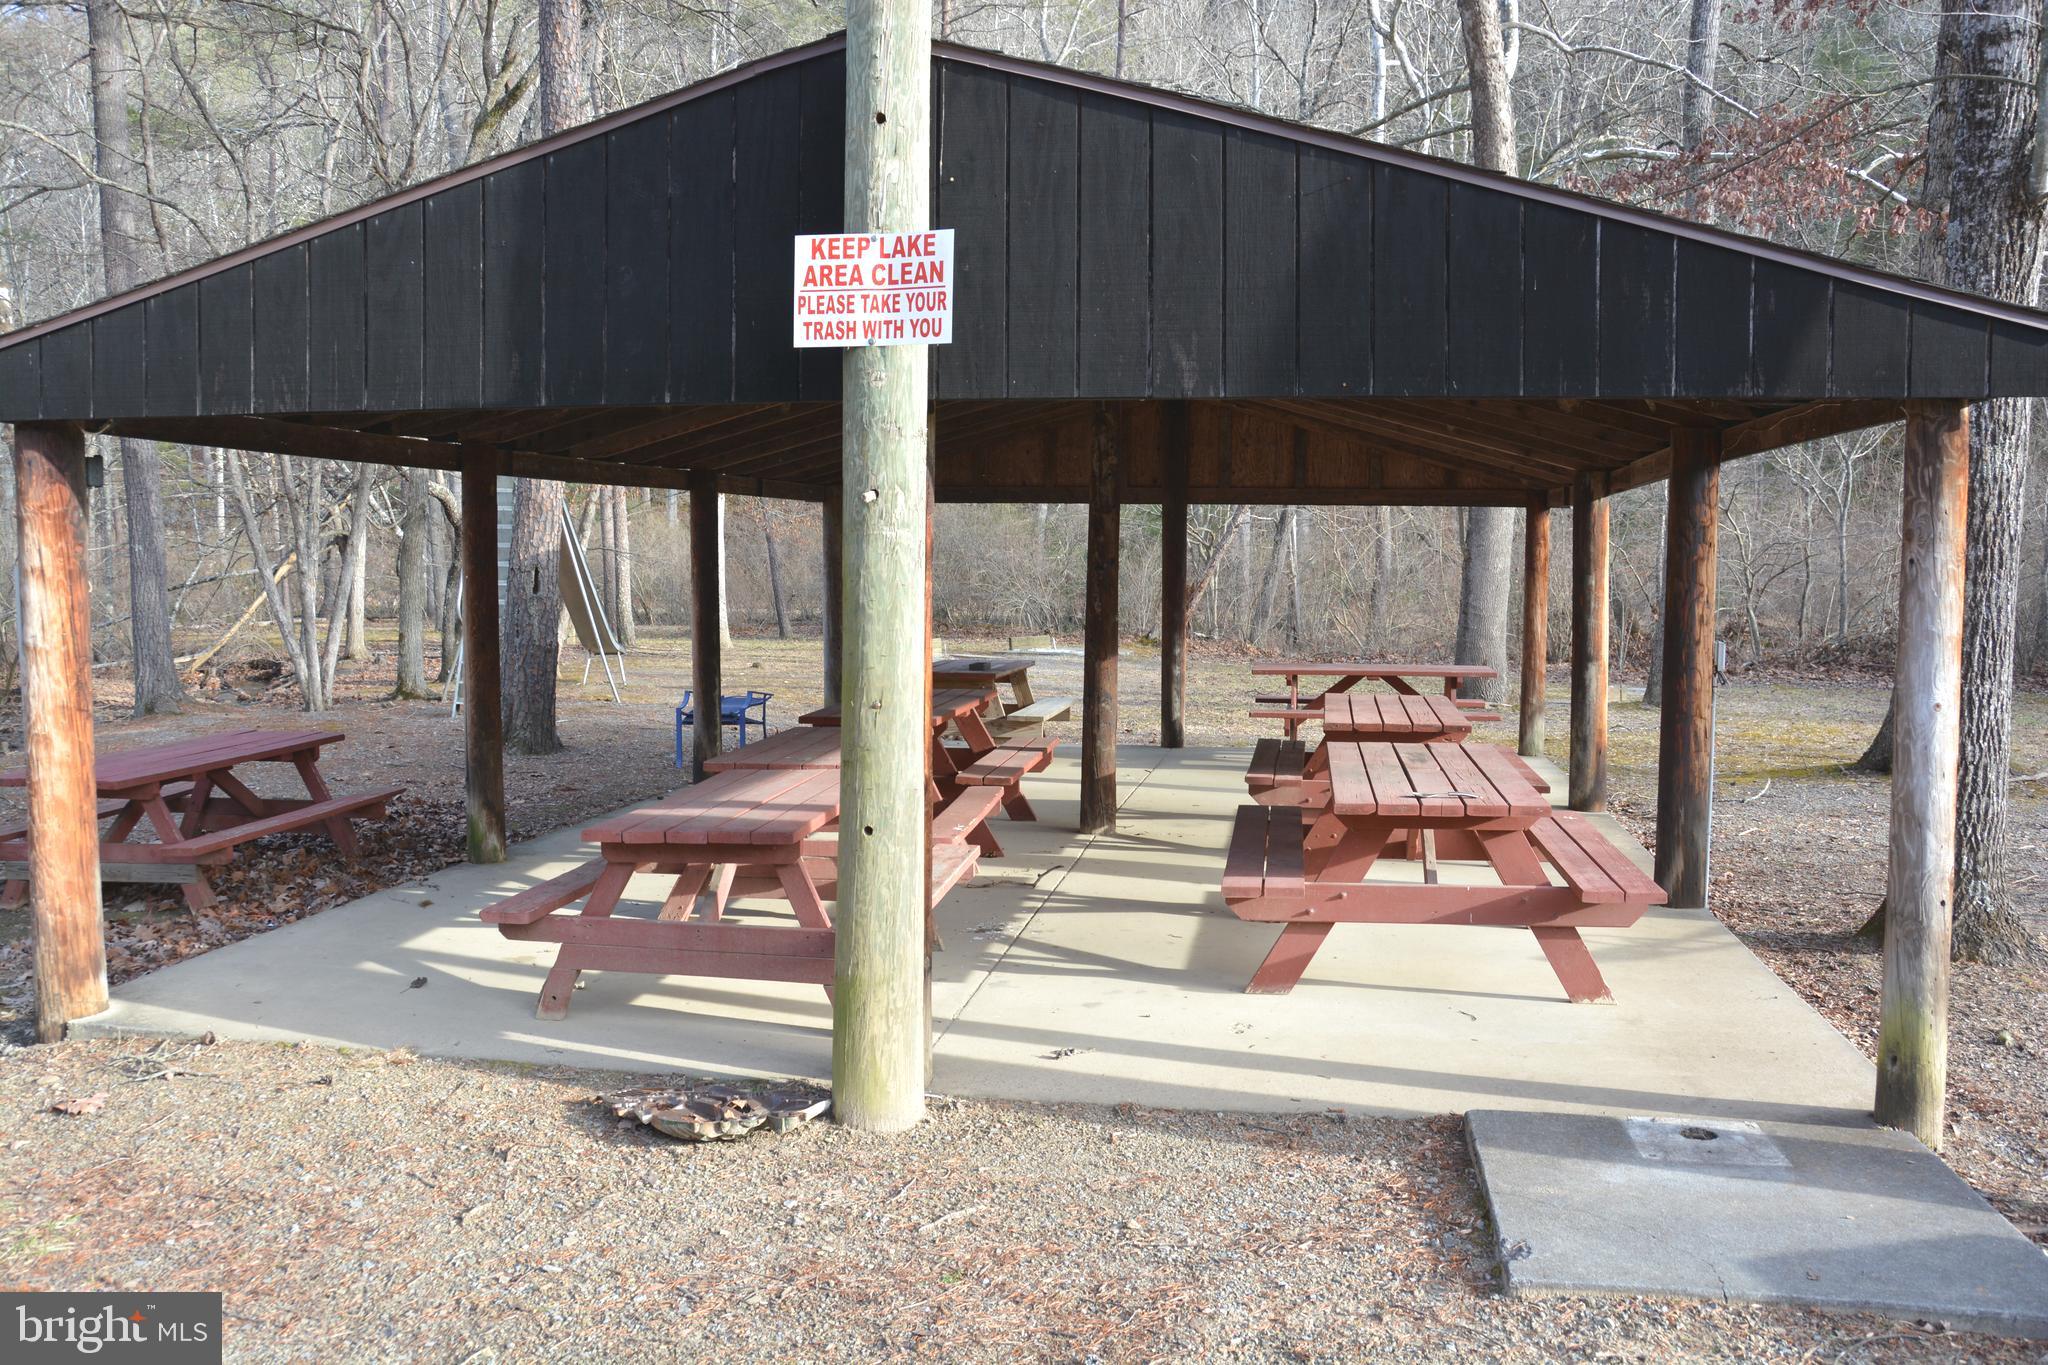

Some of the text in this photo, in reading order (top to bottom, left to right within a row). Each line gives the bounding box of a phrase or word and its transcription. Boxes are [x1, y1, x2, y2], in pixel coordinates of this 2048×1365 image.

[811, 234, 936, 260] KEEP LAKE
[803, 261, 944, 287] AREA CLEAN
[797, 291, 947, 315] PLEASE TAKE YOUR
[803, 317, 942, 340] TRASH WITH YOU
